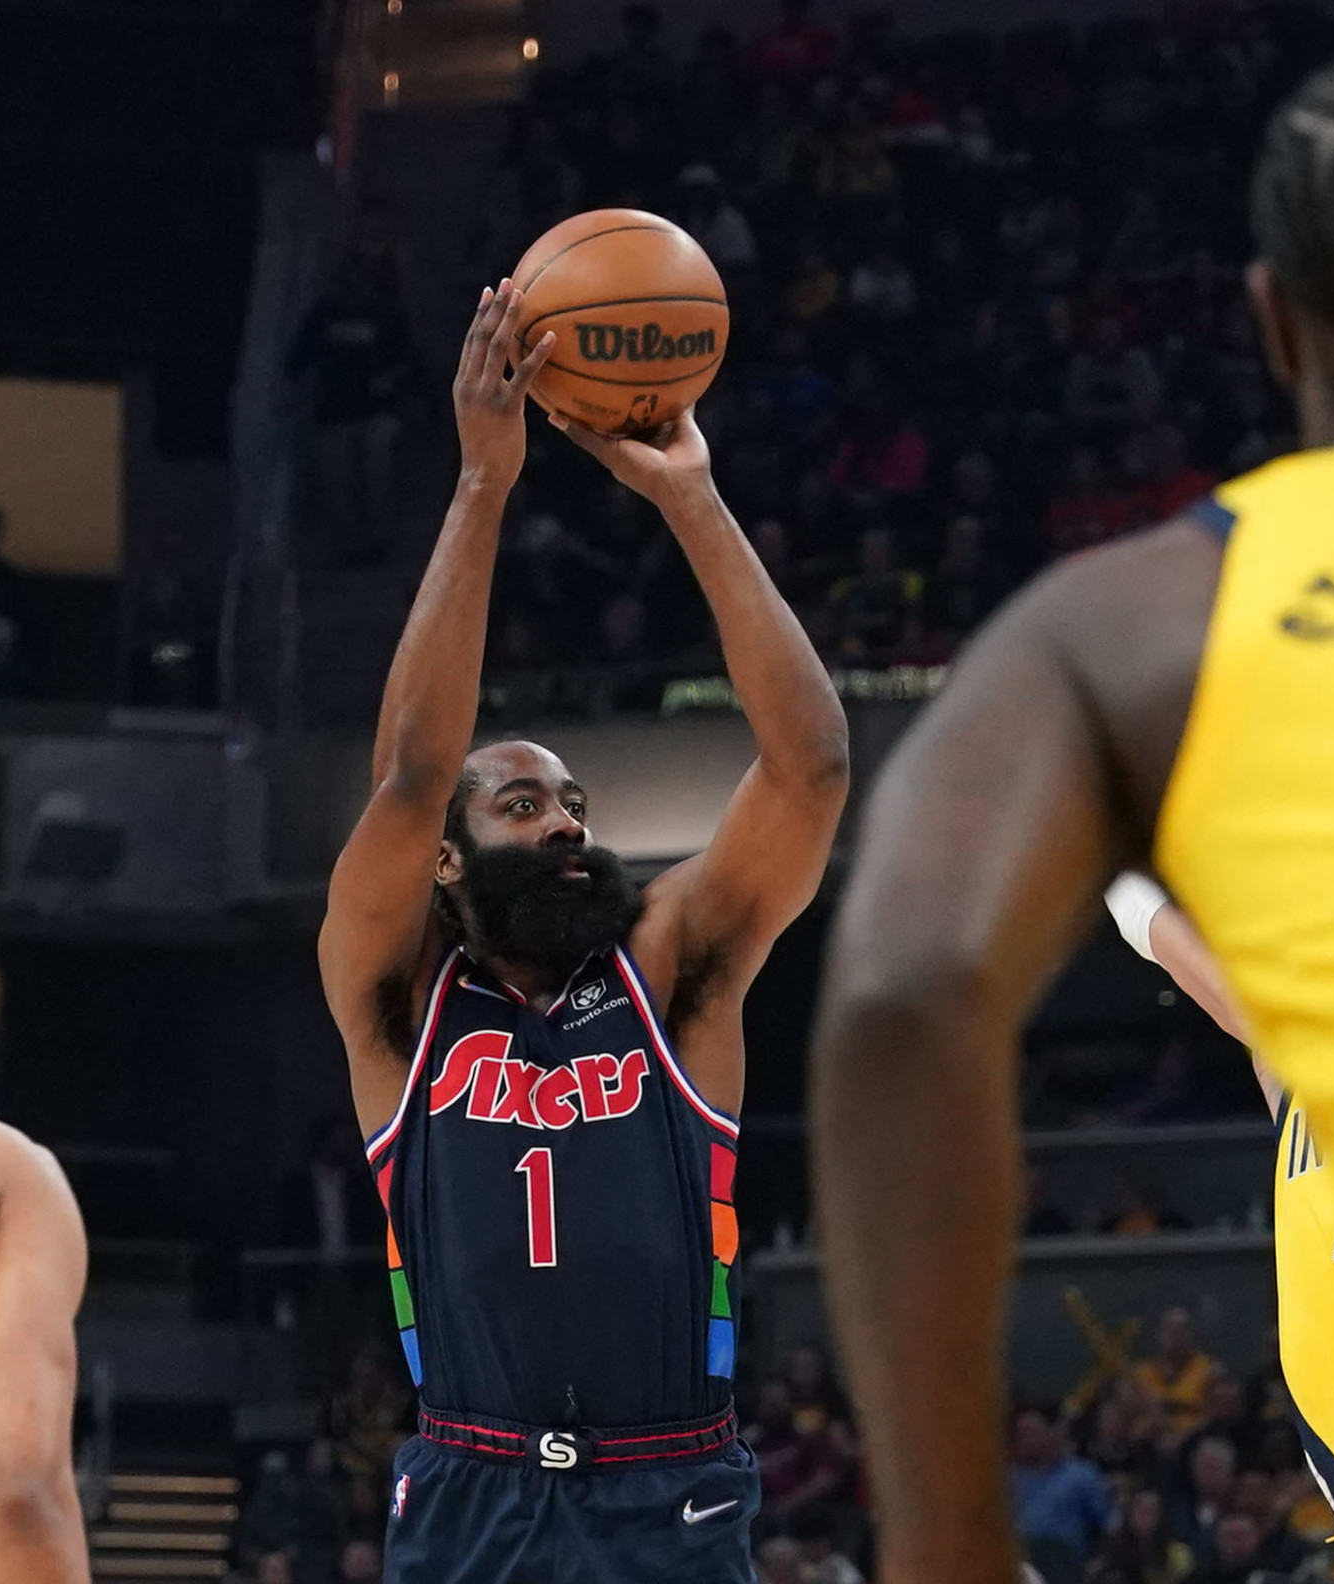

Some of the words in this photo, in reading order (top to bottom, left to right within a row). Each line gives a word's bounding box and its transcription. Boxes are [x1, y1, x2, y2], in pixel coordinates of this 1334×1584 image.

[575, 323, 715, 362] Wilson
[562, 996, 629, 1031] crypto.com
[430, 1030, 650, 1130] Sixers
[514, 1147, 557, 1268] 1
